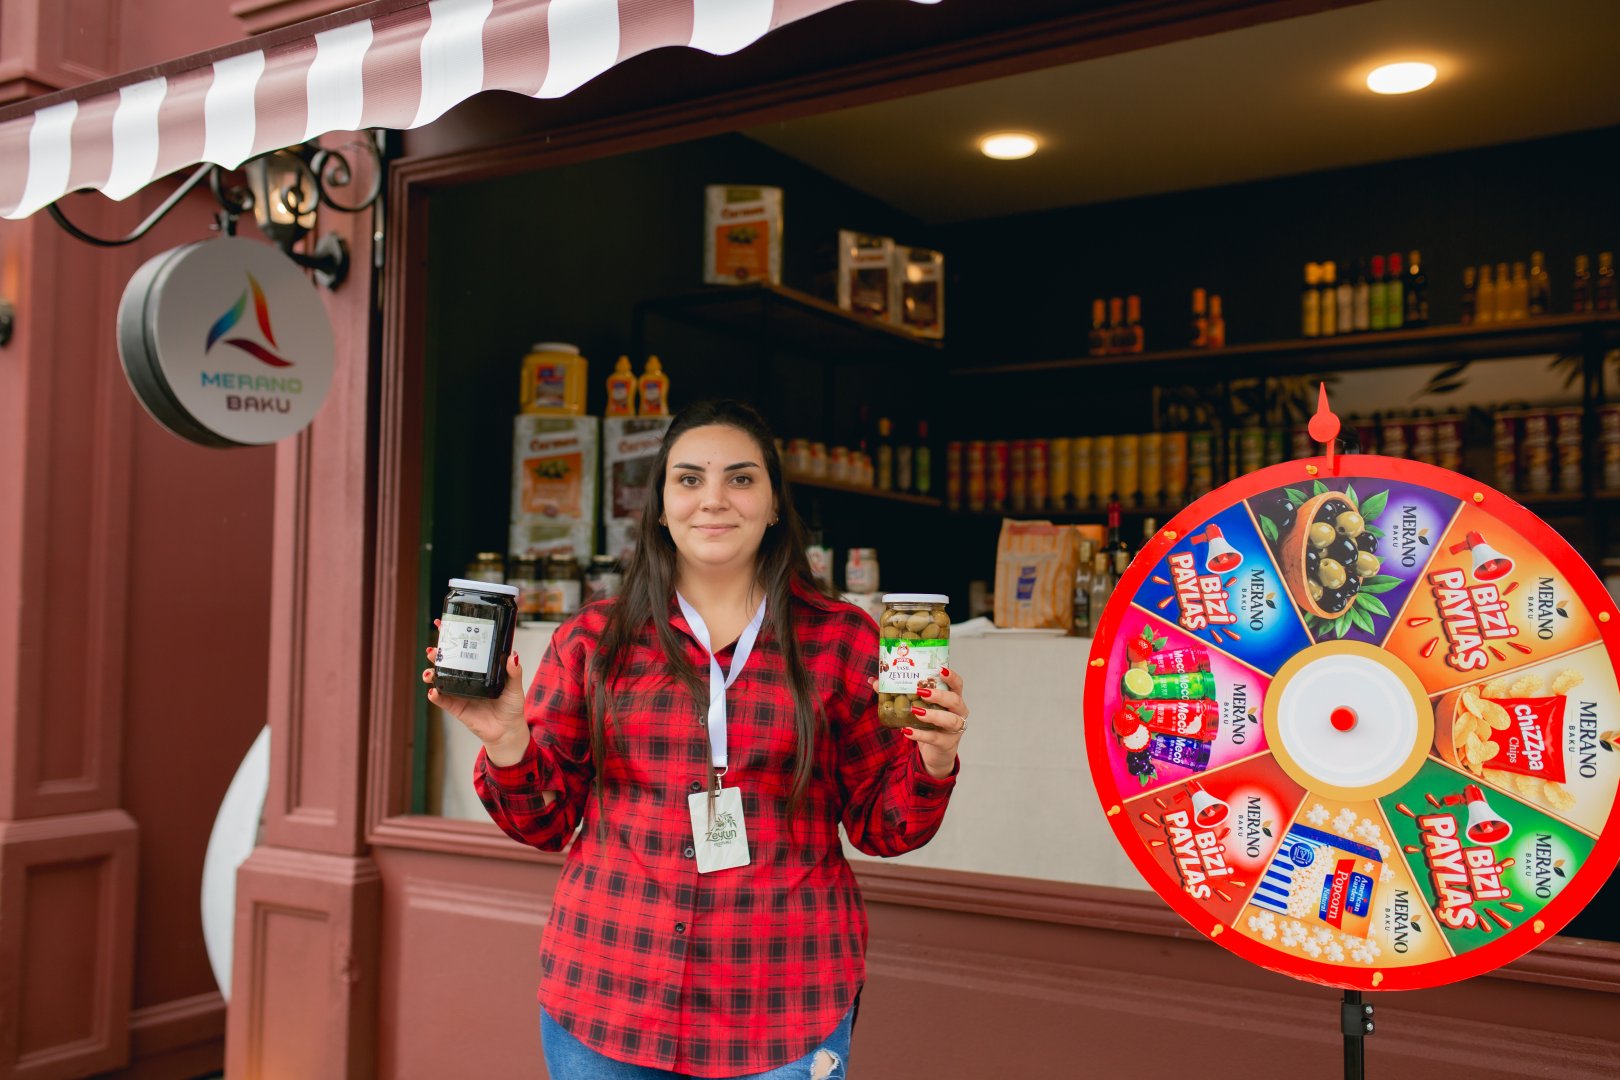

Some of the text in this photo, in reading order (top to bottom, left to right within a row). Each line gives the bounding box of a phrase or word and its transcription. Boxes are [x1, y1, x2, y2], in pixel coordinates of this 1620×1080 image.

[200, 371, 303, 394] MERANO
[226, 395, 290, 413] BAKU
[1402, 505, 1417, 568] MERANO
[1170, 553, 1207, 630] PAYLAŞ
[1249, 569, 1265, 631] MERANO
[1432, 569, 1488, 670] PAYLAŞ
[1537, 576, 1554, 640] MERANO
[888, 672, 920, 681] ZEYTUN
[1177, 702, 1189, 734] Meco
[1231, 683, 1247, 745] MERANO
[1579, 701, 1597, 779] MERANO
[1173, 737, 1186, 764] Meco
[1507, 736, 1519, 764] Chips
[705, 829, 737, 842] Zeytun
[1165, 810, 1211, 899] PAYLAŞ
[1246, 796, 1261, 858] MERANO
[1328, 870, 1349, 919] Popcorn
[1349, 875, 1361, 902] Garden
[1354, 876, 1369, 912] American
[1422, 816, 1477, 927] PAYLAŞ
[1535, 833, 1552, 899] MERANO
[1320, 887, 1331, 913] Natural
[1393, 889, 1409, 954] MERANO
